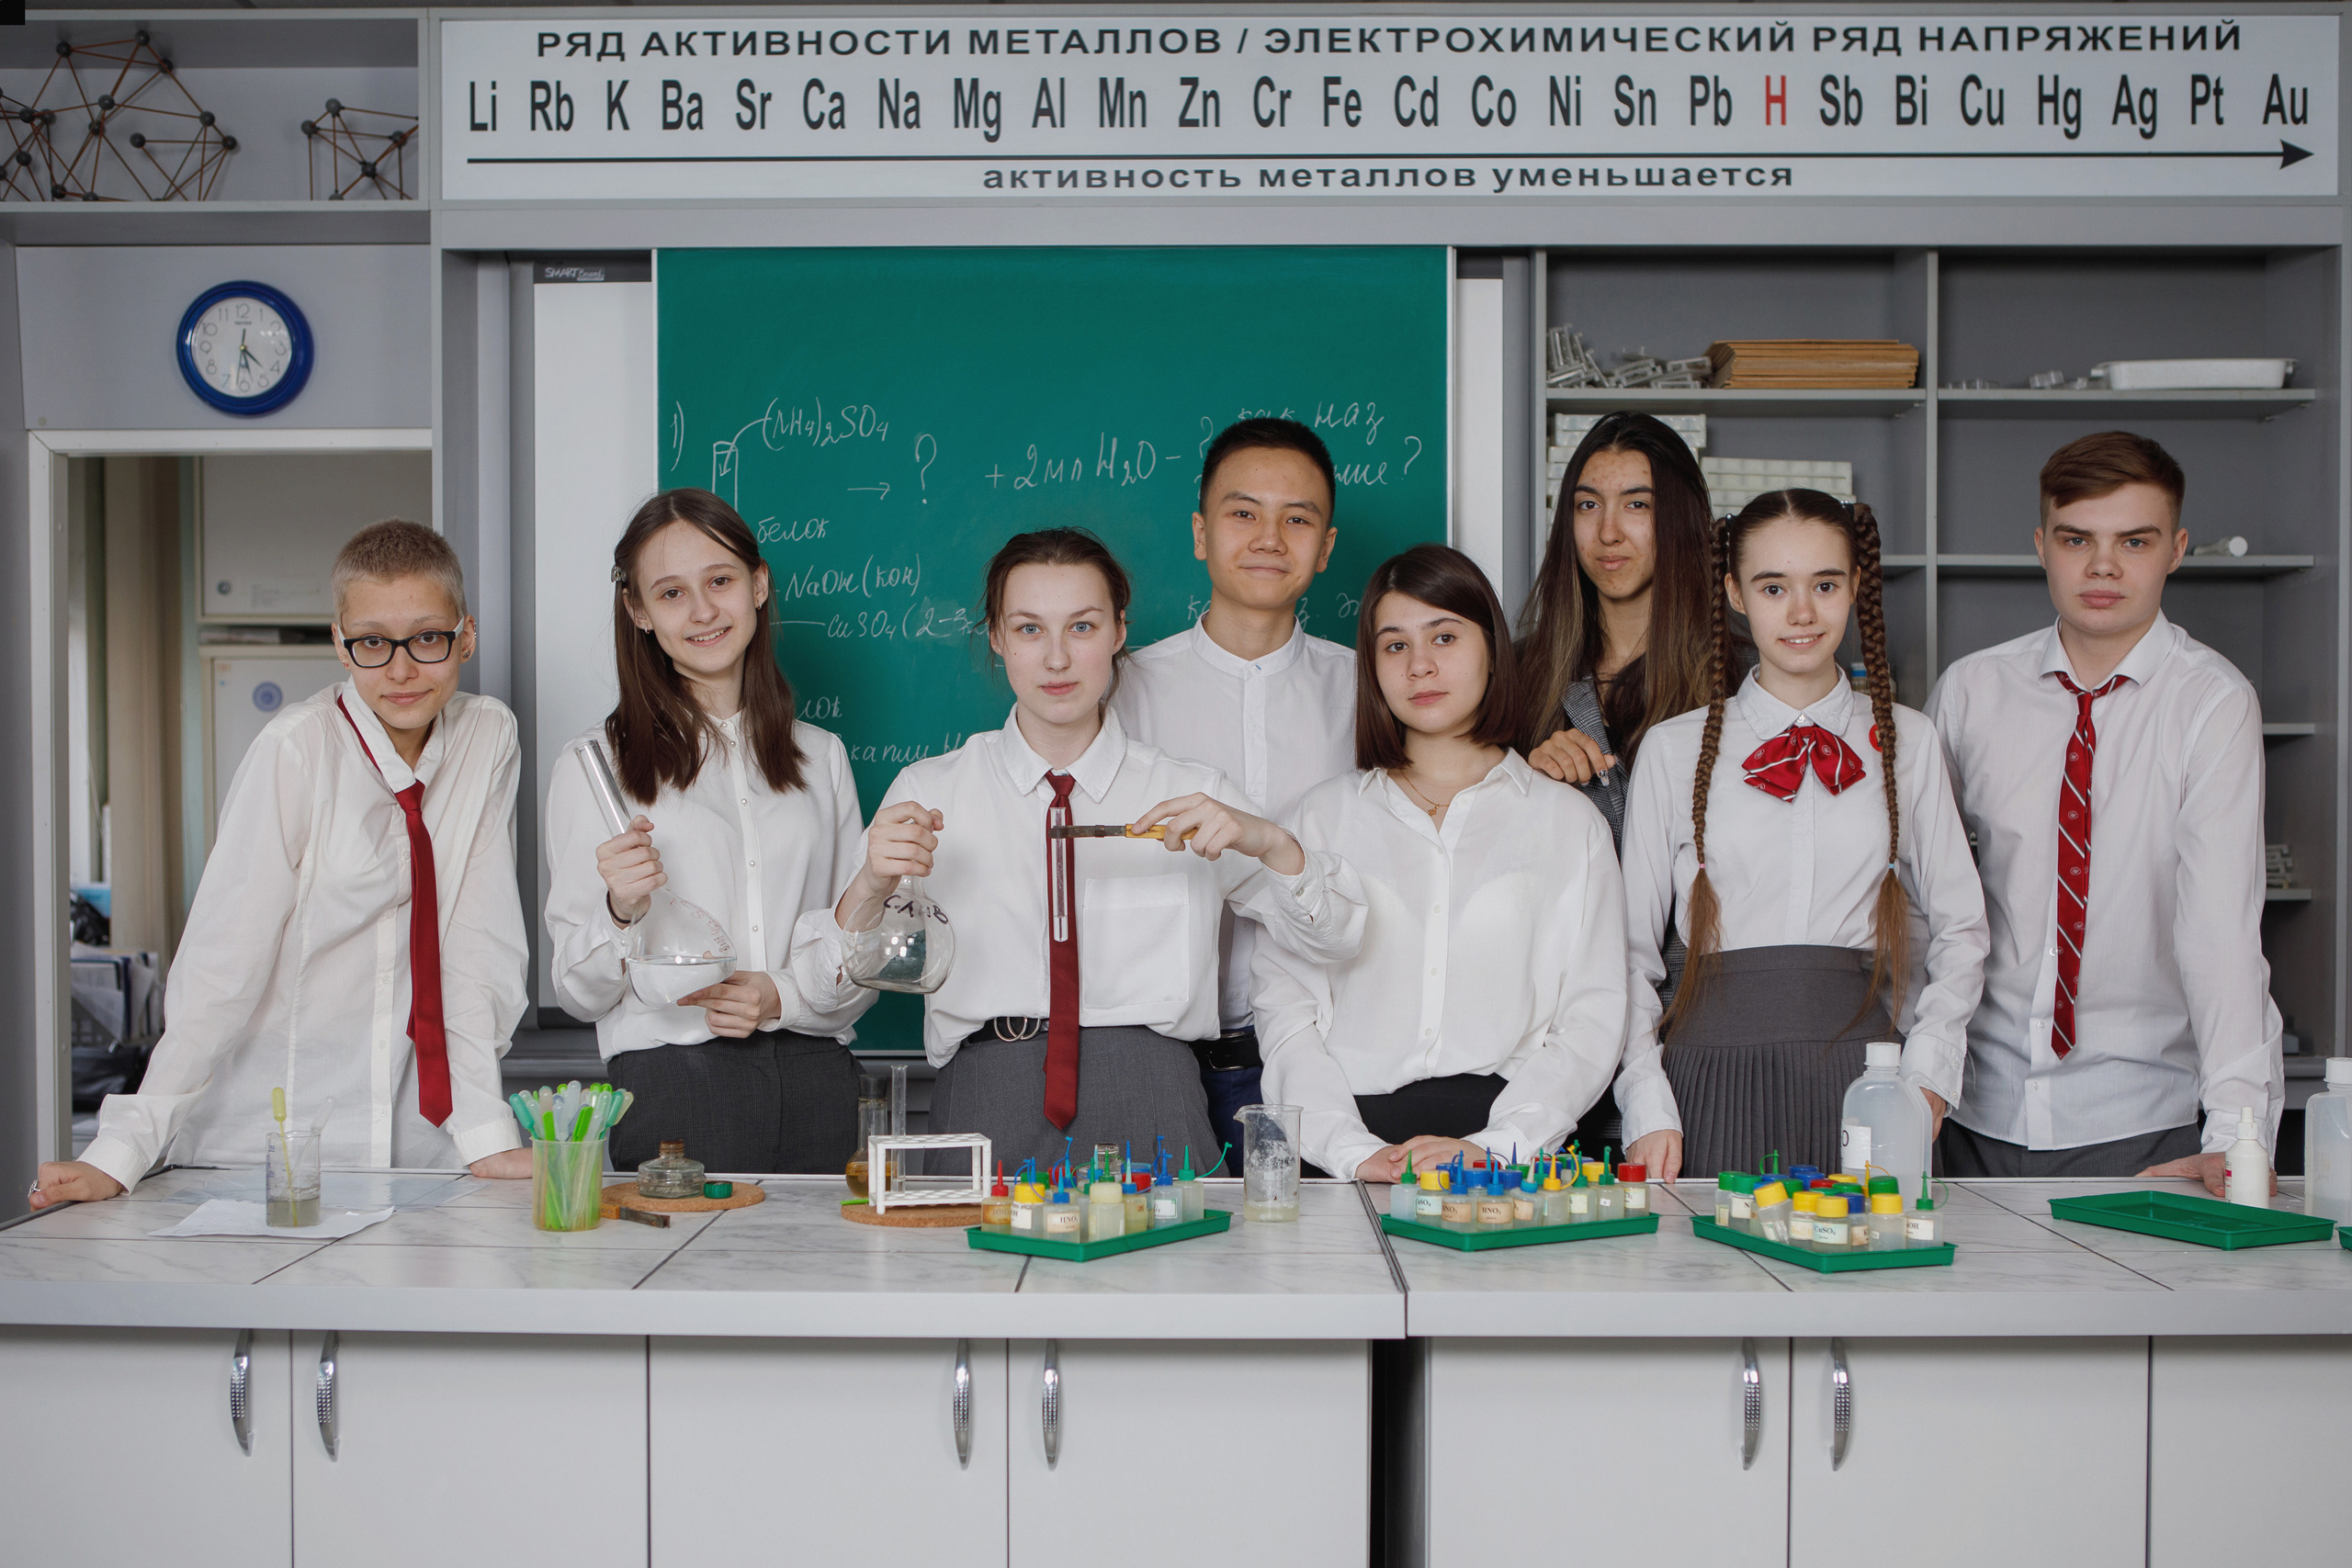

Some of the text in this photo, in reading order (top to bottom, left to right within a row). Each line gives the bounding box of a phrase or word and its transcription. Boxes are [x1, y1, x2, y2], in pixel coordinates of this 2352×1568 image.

[537, 20, 2240, 62] РЯД АКТИВНОСТИ МЕТАЛЛОВ / ЭЛЕКТРОХИМИЧЕСКИЙ РЯД НАПРЯЖЕНИЙ
[469, 73, 2308, 140] Li Rb K Ba Sr Ca Na Mg Al Mn Zn Cr Fe Cd Co Ni Sn Pb H Sb Bi Cu Hg Ag Pt Au
[984, 167, 1792, 193] активность металлов уменьшается
[219, 308, 228, 321] 11
[236, 303, 250, 319] 12
[260, 308, 264, 321] 1
[203, 322, 218, 337] 10
[200, 340, 212, 355] 9
[206, 359, 217, 375] 8
[270, 360, 280, 374] 4
[221, 374, 232, 389] 7
[239, 378, 251, 393] 6
[257, 374, 269, 389] 5
[915, 434, 937, 504] ?
[757, 515, 830, 543] белок
